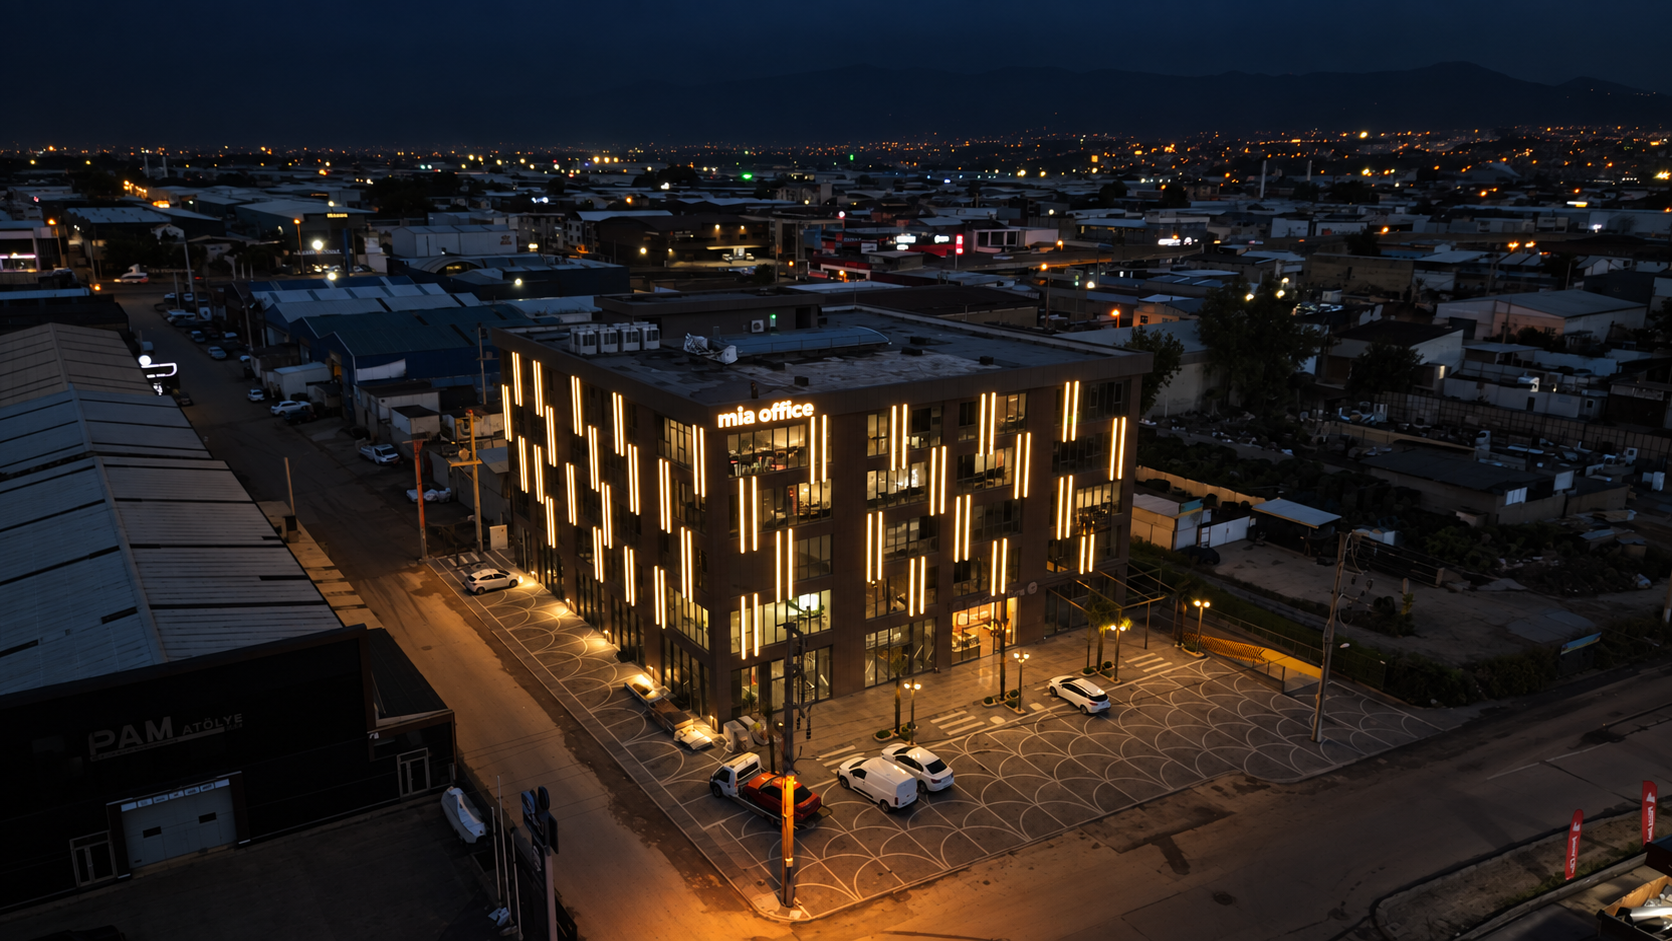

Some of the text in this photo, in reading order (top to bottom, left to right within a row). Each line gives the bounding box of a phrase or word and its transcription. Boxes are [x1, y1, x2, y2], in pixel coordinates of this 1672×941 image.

[718, 401, 814, 428] mia office
[88, 716, 173, 758] PAM
[182, 713, 242, 735] ATÖLYE
